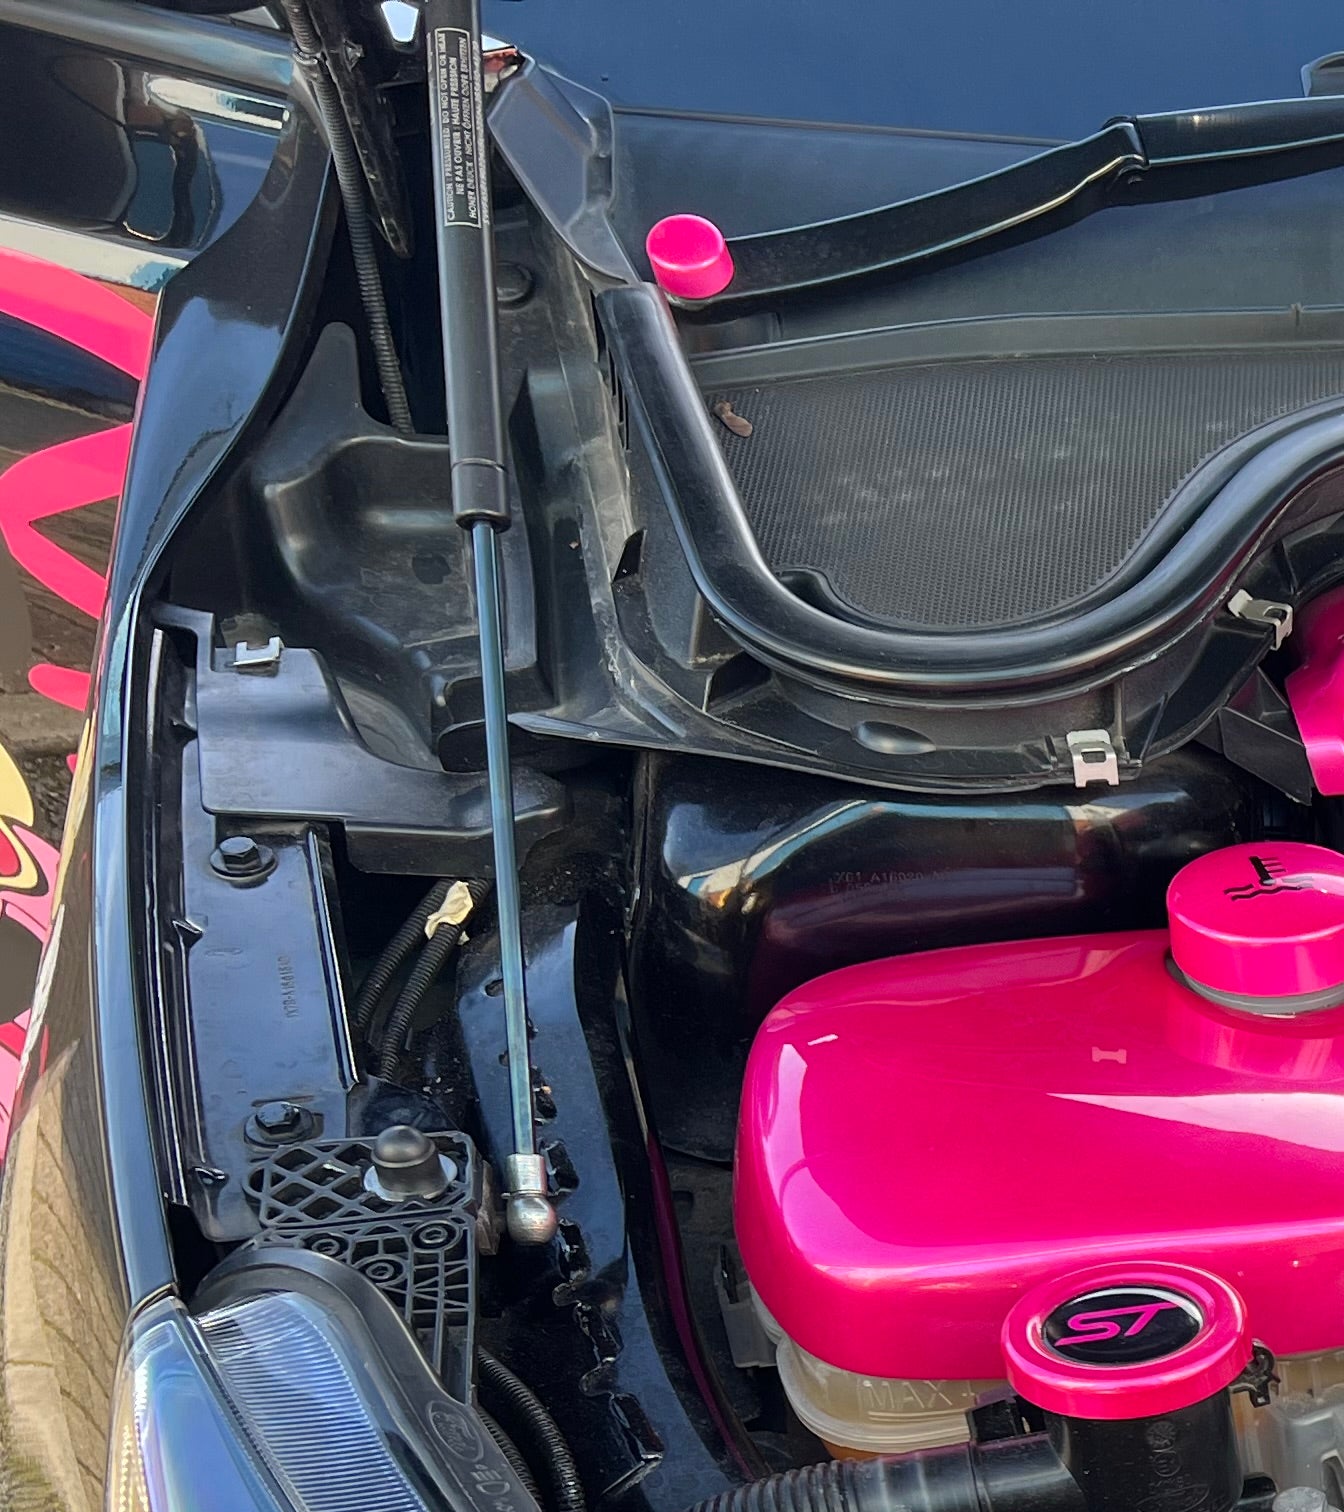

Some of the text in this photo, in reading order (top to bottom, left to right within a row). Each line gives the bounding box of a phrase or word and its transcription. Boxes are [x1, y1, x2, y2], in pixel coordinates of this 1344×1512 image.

[439, 54, 446, 67] OR
[442, 111, 449, 124] DO
[1054, 1301, 1181, 1347] ST
[863, 1380, 953, 1410] MAX
